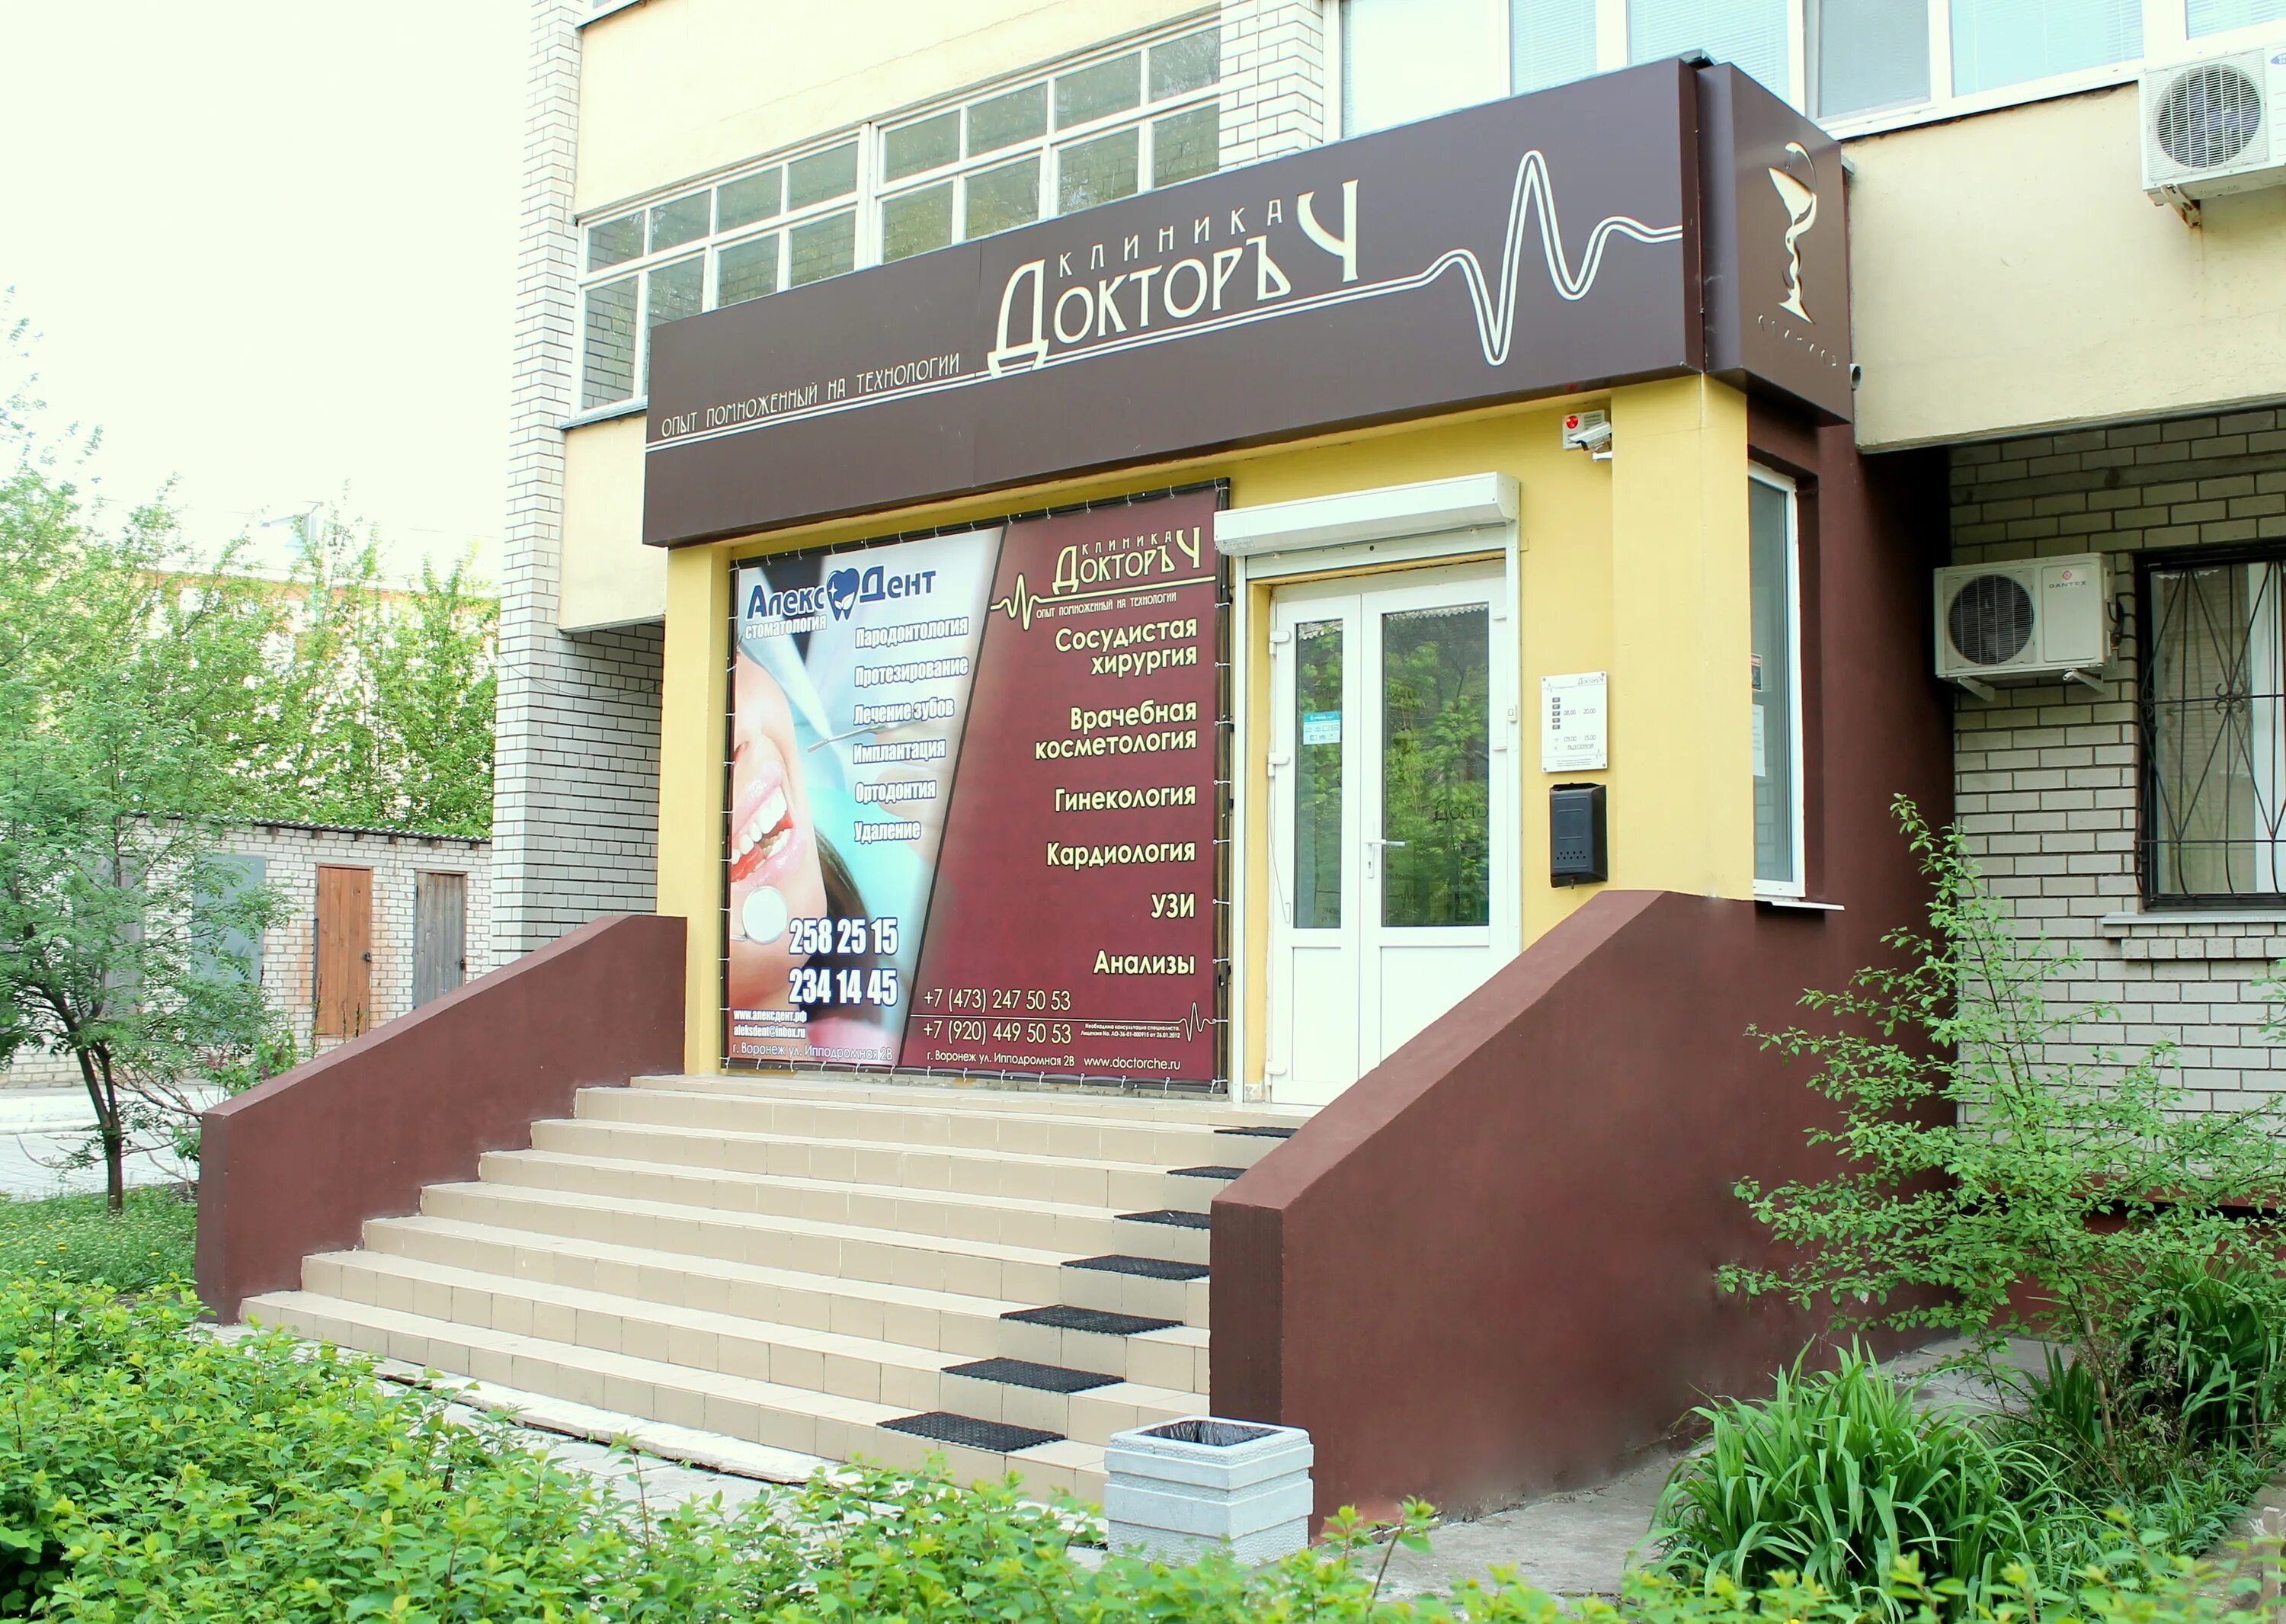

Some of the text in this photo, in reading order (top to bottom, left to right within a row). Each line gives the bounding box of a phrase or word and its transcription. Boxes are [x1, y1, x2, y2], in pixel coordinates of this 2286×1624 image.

[1059, 198, 1283, 277] КЛИНИКА
[1297, 179, 1359, 282] Ч
[661, 352, 960, 437] ОПЫТ ПОМНОЖЕННЫЙ НА ТЕХНОЛОГИИ
[1081, 530, 1173, 556] КЛИНИКА
[1176, 527, 1201, 569] Ч
[2048, 580, 2086, 589] DANTEX
[1036, 592, 1177, 619] ОПЫТ ПОМНОЖЕННЫЙ НА ТЕХНОЛОГИИ
[744, 615, 827, 641] стоматология
[855, 617, 969, 649] Пародонтология
[1055, 617, 1197, 652] Сосудистая
[854, 656, 969, 688] Протезирование
[1091, 645, 1197, 677] хирургия
[853, 697, 955, 726] Лечение зубов
[1070, 700, 1197, 735] Врачебная
[853, 738, 946, 764] Имплантация
[1035, 729, 1197, 761] косметология
[854, 780, 936, 805] Ортодонтия
[1055, 786, 1196, 812] Гинекология
[853, 821, 921, 844] Удаление
[1046, 841, 1196, 870] Кардиология
[1151, 892, 1195, 918] УЗИ
[789, 918, 898, 955] 258 25 15
[1093, 950, 1195, 975] Анализы
[789, 969, 898, 1006] 234 14 45
[924, 988, 1071, 1013] +7 (473) 247 50 53
[733, 1009, 808, 1023] www.алексдент.рф
[733, 1025, 806, 1038] aleksdent@inbox.ru
[923, 1020, 1071, 1045] +7 (920) 449 50 53
[732, 1044, 739, 1053] г.
[741, 1043, 786, 1056] Воронеж
[789, 1046, 802, 1058] ул.
[805, 1045, 878, 1060] Ипподромная
[927, 1051, 934, 1061] г.
[935, 1050, 976, 1065] Воронеж
[978, 1054, 992, 1066] ул.
[994, 1052, 1061, 1070] Ипподромная
[1084, 1057, 1181, 1071] www.doctorche.ru
